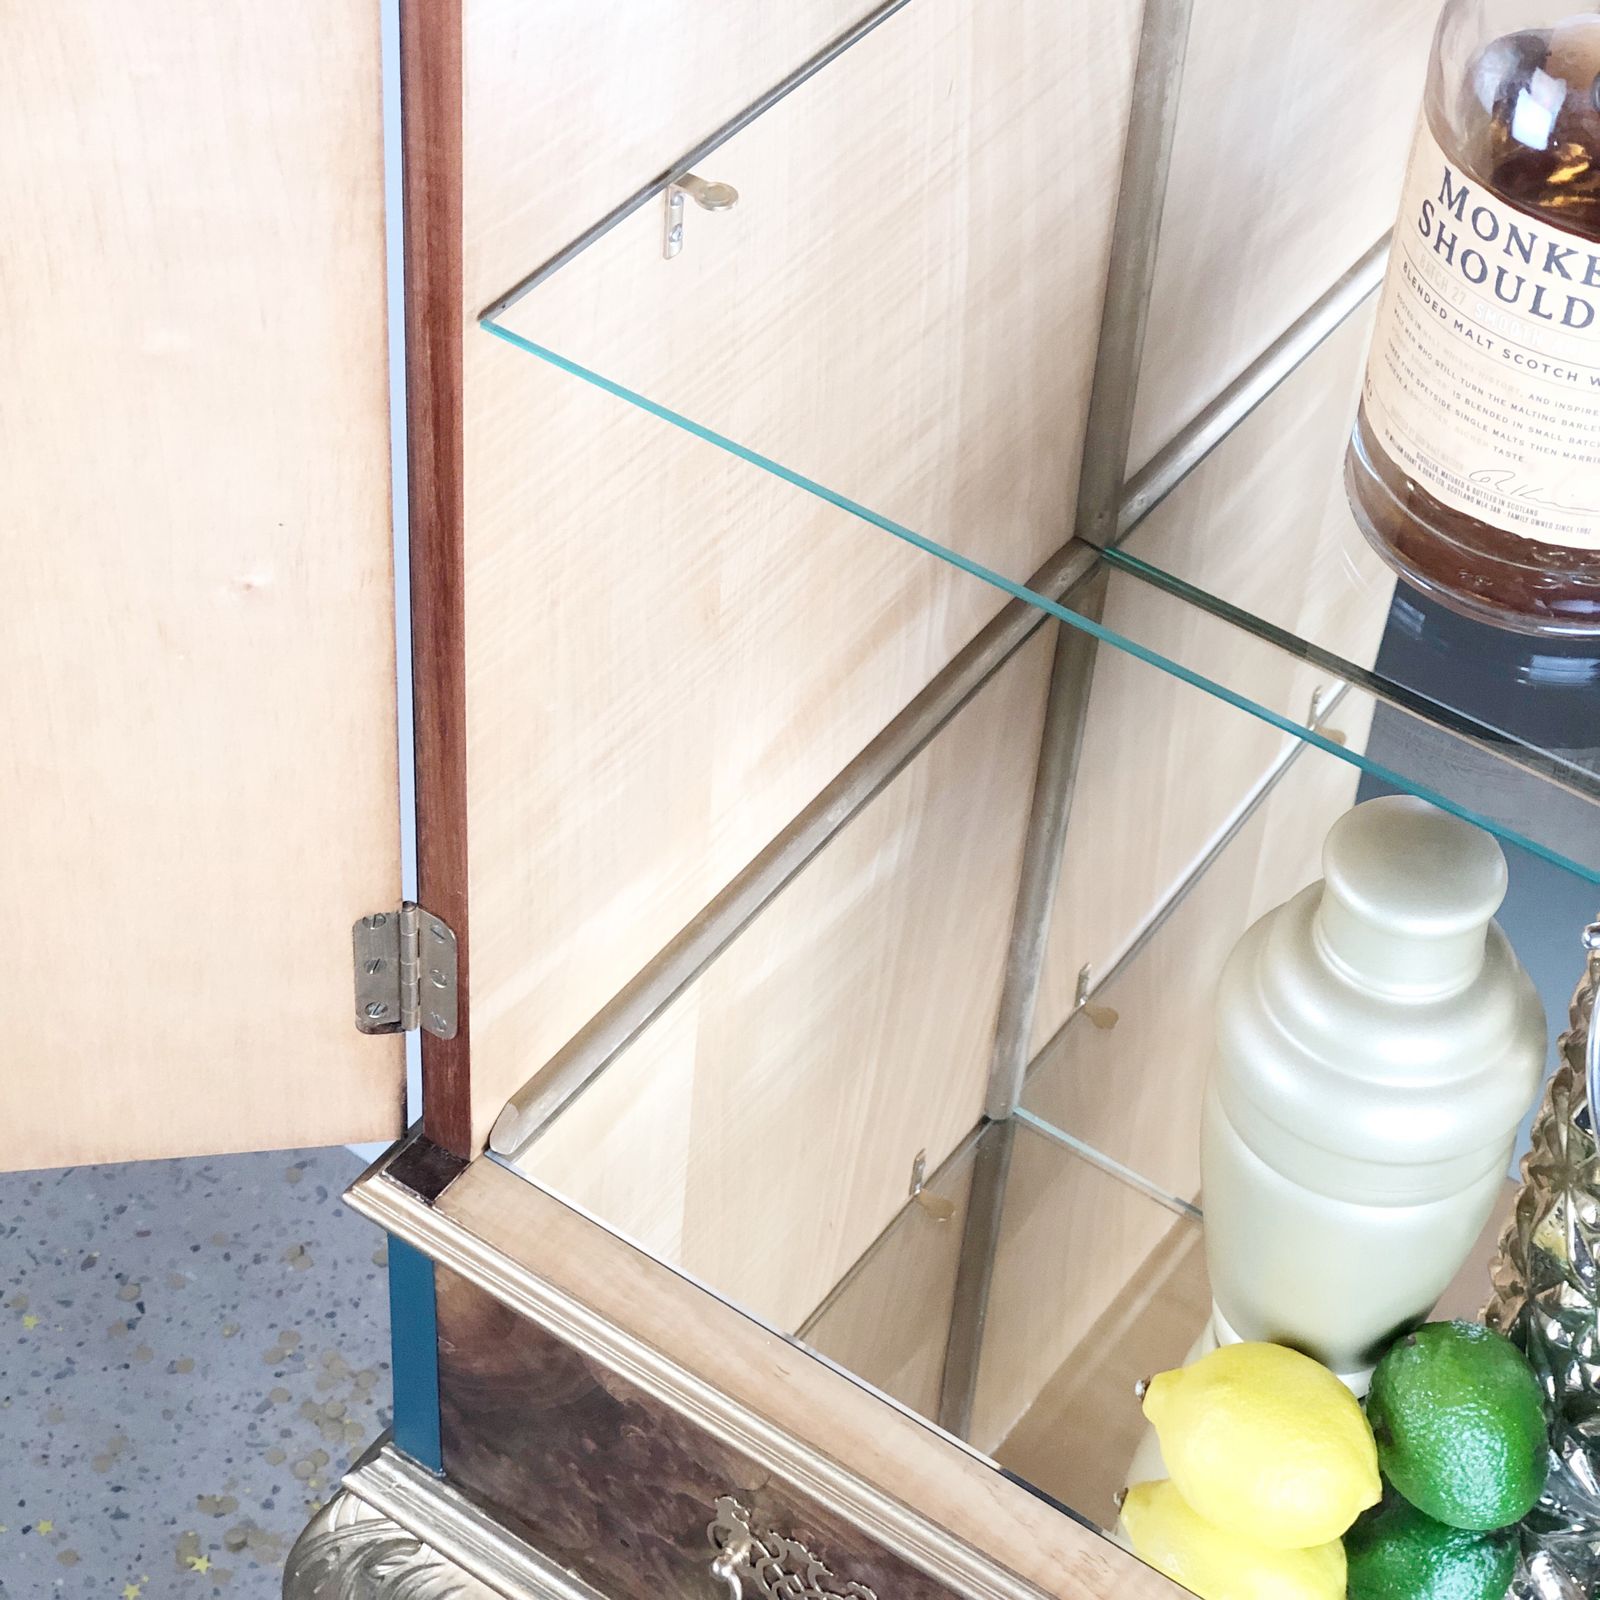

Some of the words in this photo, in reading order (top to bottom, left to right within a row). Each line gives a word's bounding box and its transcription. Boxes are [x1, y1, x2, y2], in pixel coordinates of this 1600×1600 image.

[1418, 199, 1595, 329] SHOULD
[1403, 260, 1448, 320] BLENDED
[1453, 319, 1495, 350] MALT
[1502, 348, 1578, 382] SCOTCH
[1434, 358, 1457, 381] STILL
[1460, 377, 1484, 396] TURN
[1488, 392, 1507, 407] THE
[1510, 403, 1557, 424] MALTING
[1561, 419, 1600, 433] BARLE
[1465, 397, 1509, 424] BLENDED
[1512, 420, 1524, 430] IN
[1528, 425, 1563, 442] SMALL
[1528, 393, 1551, 406] AND
[1455, 408, 1488, 433] SINGLE
[1492, 428, 1525, 447] MALTS
[1530, 442, 1558, 457] THEN
[1507, 501, 1539, 517] SCOTLAND
